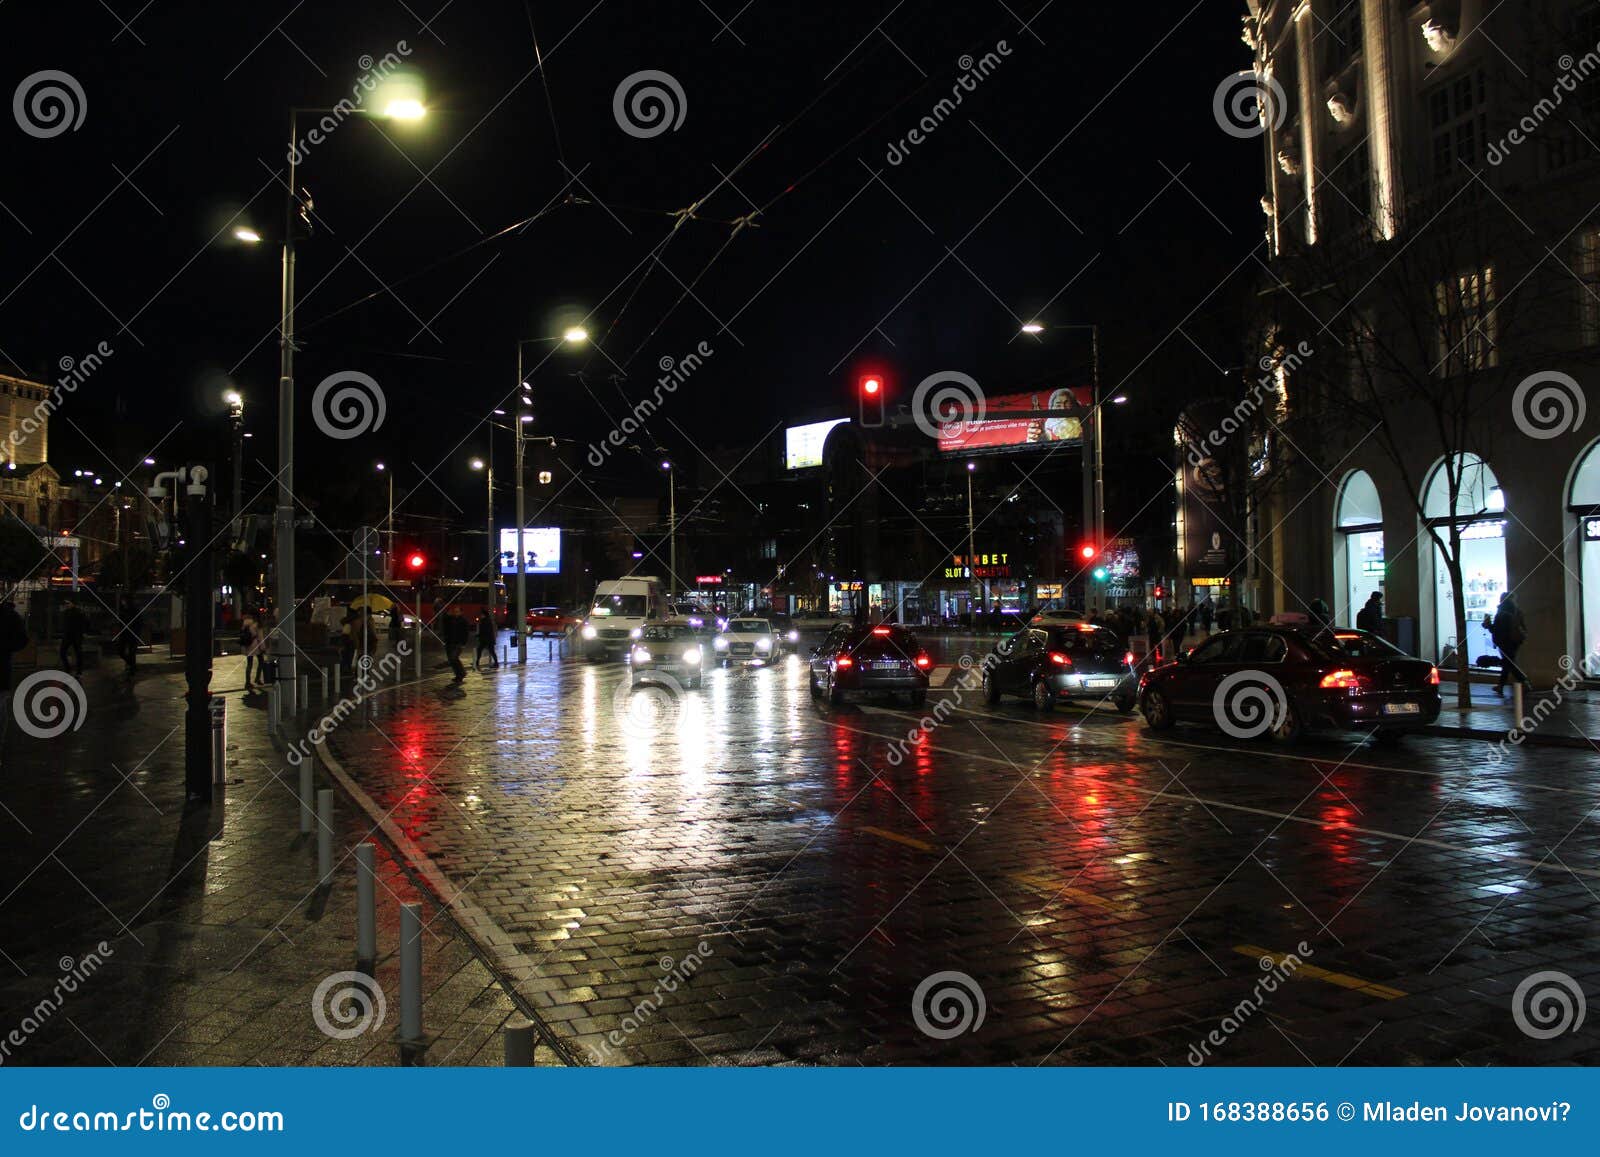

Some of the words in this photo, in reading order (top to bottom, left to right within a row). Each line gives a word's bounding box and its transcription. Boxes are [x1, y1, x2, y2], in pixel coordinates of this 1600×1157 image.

[954, 554, 1007, 565] WINBET
[945, 567, 962, 578] SLOT
[964, 567, 970, 578] &
[1192, 578, 1225, 586] WINBET
